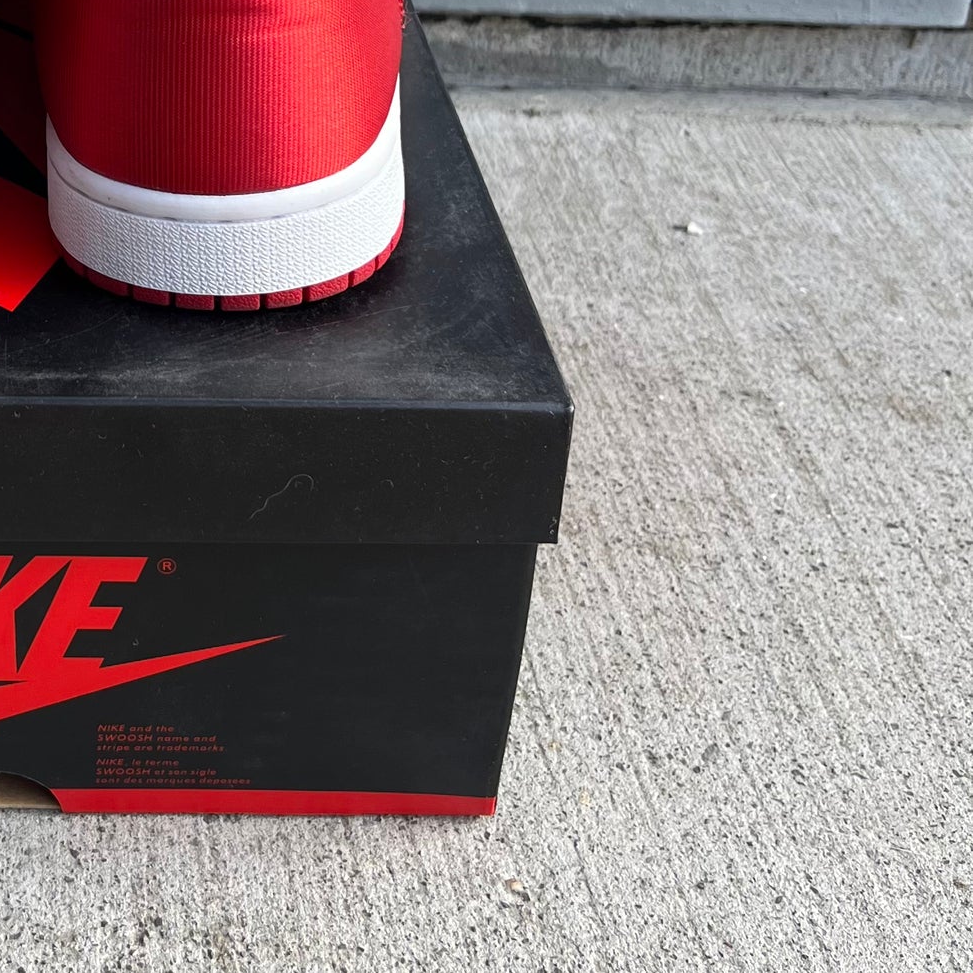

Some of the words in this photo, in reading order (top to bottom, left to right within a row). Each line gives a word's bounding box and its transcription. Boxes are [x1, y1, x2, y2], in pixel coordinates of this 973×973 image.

[97, 724, 126, 732] NIKE
[129, 724, 152, 732] and
[156, 724, 175, 732] the
[97, 734, 153, 742] SWOOSH
[96, 744, 130, 752] stripe
[156, 744, 224, 752] trademarks
[131, 758, 142, 766] le
[95, 767, 151, 775] SWOOSH
[190, 768, 217, 777] sigle
[146, 777, 196, 785] marques
